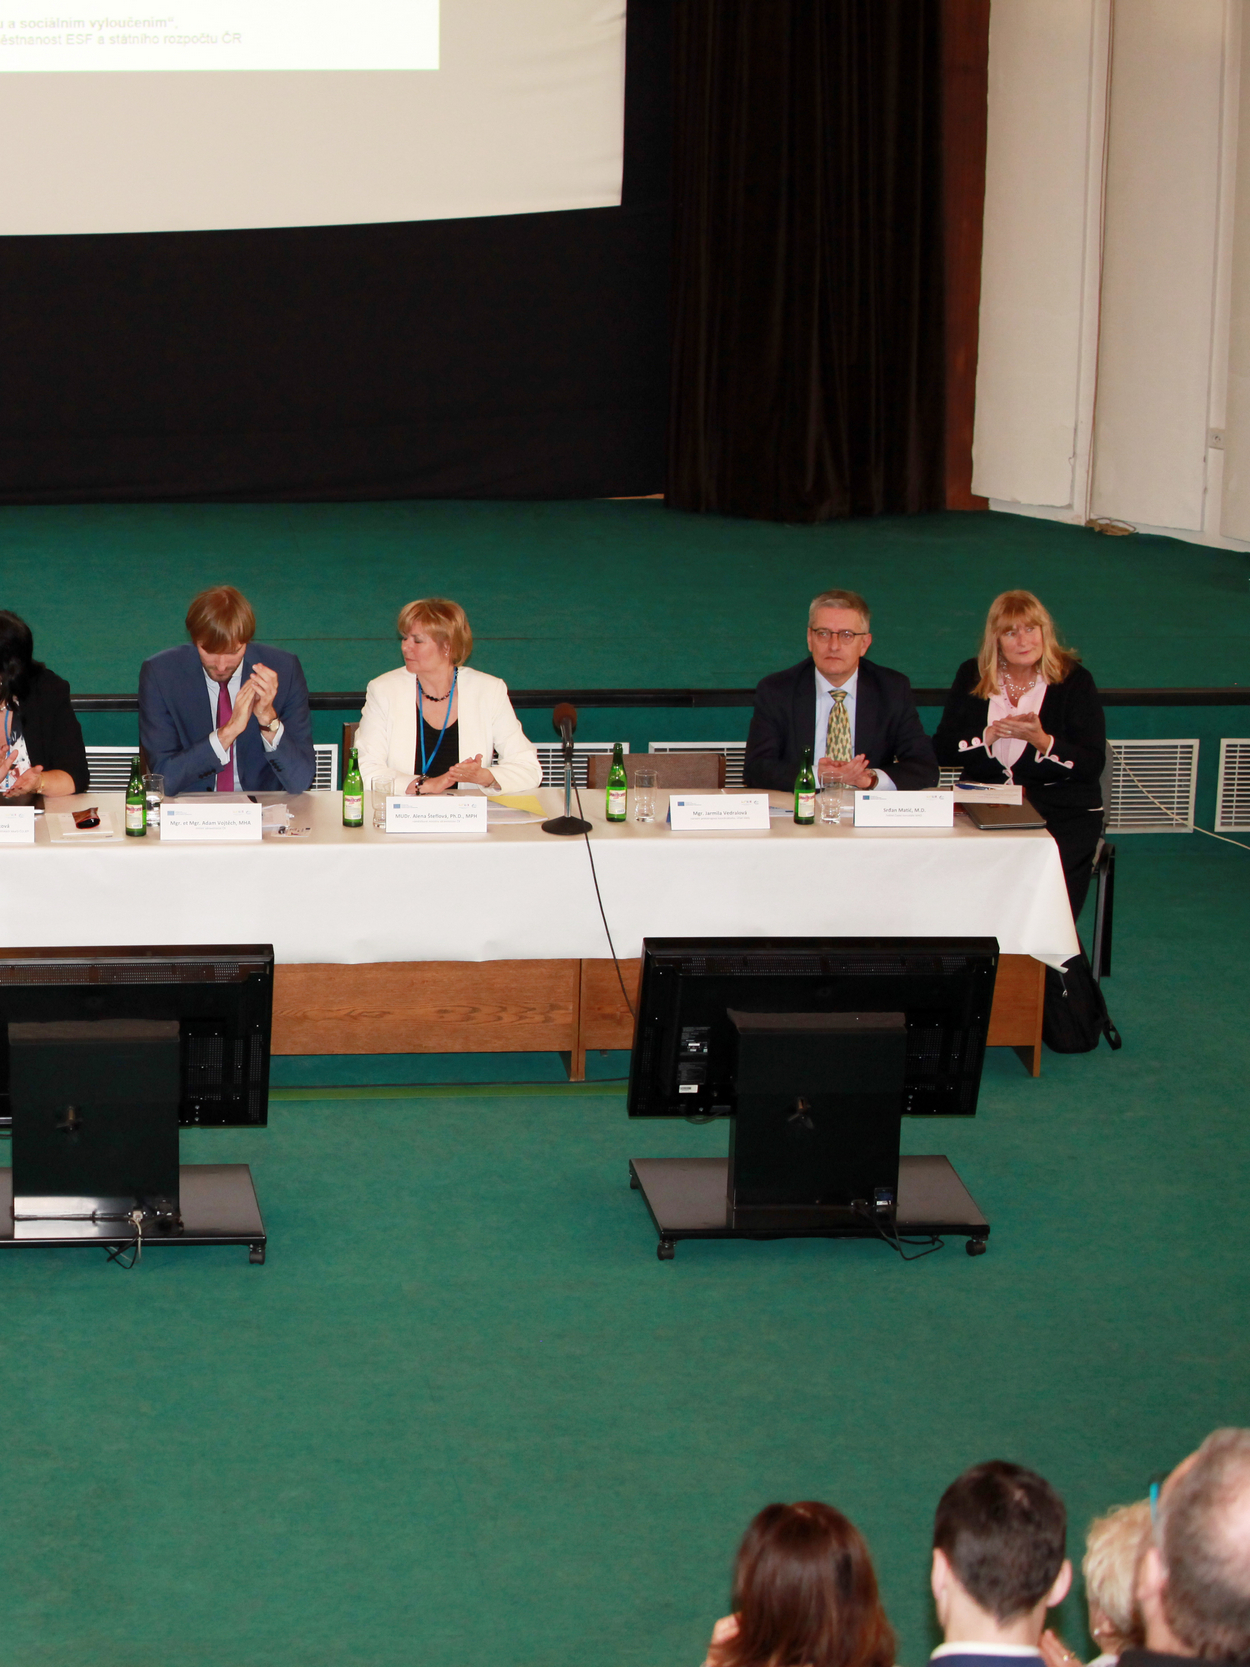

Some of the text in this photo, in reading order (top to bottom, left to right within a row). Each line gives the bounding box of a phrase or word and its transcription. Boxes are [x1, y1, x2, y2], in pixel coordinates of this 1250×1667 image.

[8, 20, 15, 29] a
[65, 33, 93, 45] ESF
[96, 35, 104, 44] a
[162, 32, 217, 47] rozpočtu
[220, 30, 242, 44] ČR
